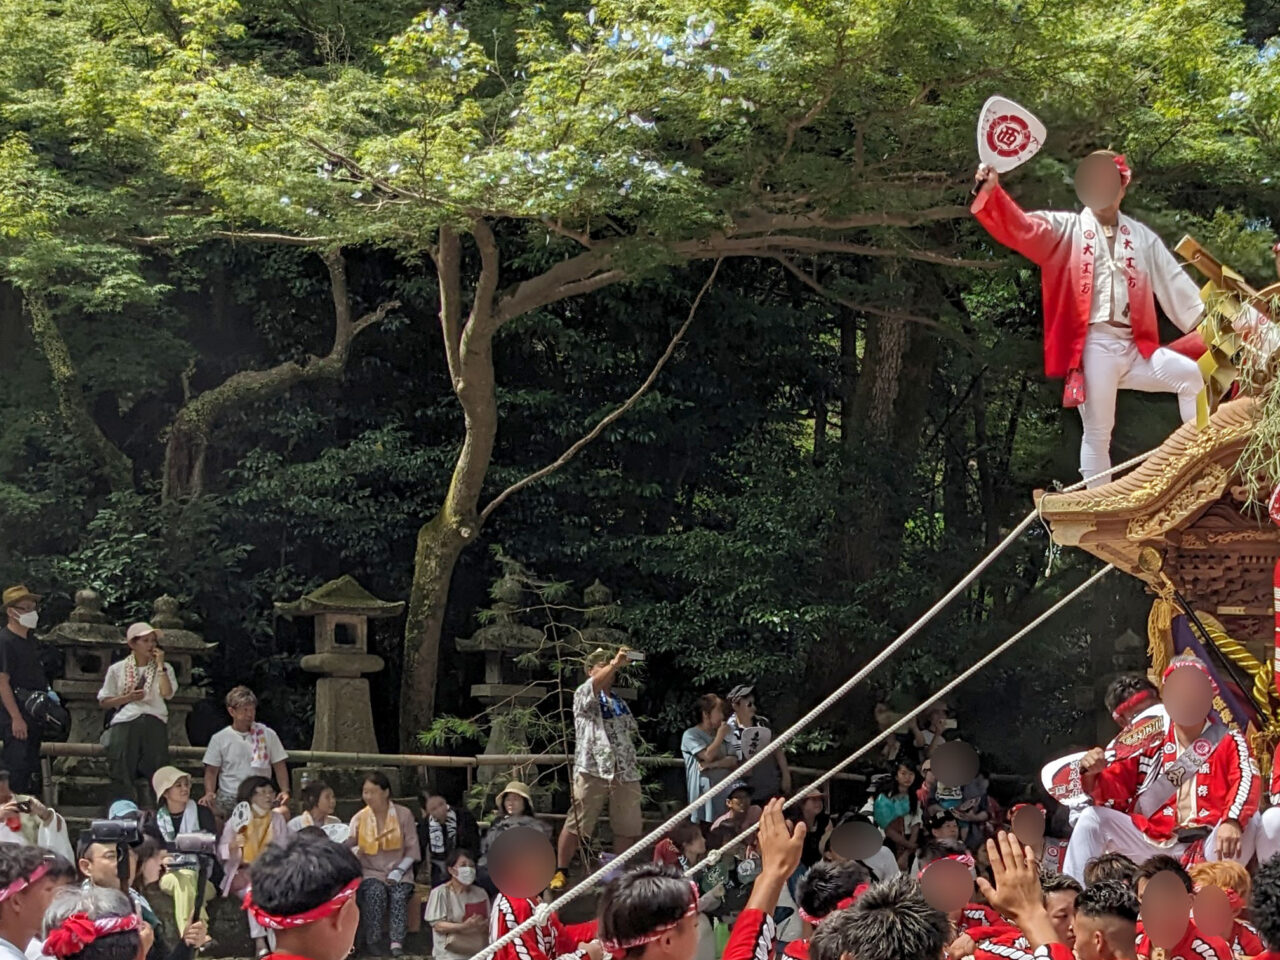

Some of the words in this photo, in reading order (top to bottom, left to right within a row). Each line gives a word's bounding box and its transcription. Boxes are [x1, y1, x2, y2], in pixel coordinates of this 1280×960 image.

[1082, 244, 1095, 294] 大工方
[1122, 238, 1136, 290] 大工方
